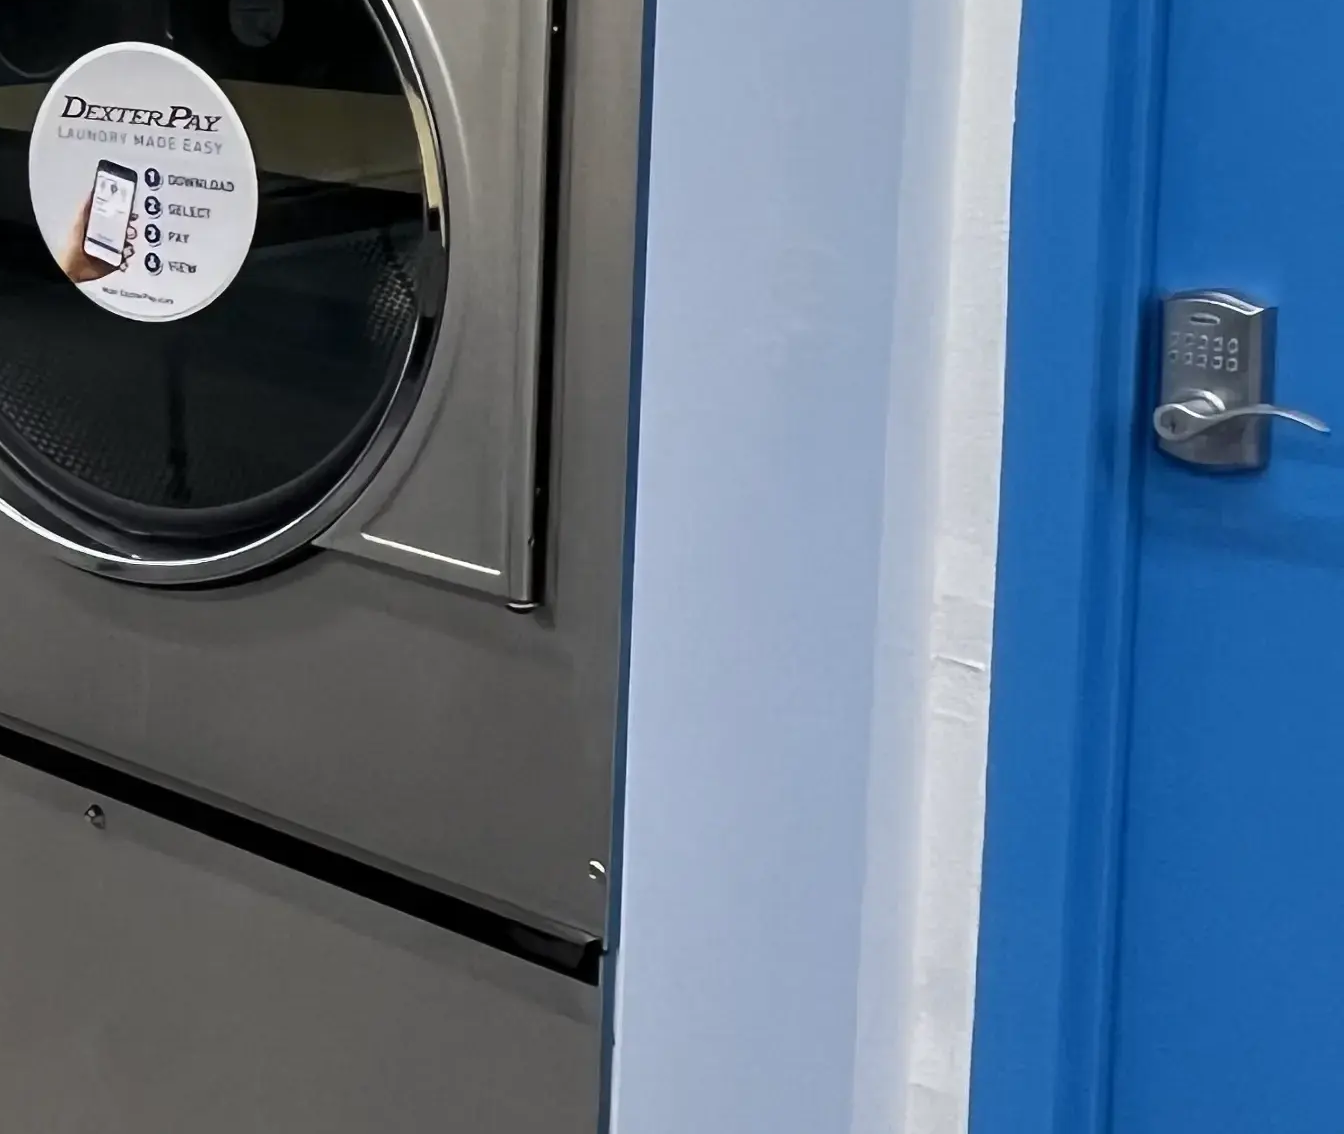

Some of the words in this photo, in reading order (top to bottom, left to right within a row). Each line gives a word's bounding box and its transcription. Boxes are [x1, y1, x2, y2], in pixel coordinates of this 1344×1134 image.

[58, 124, 127, 146] LAUNDRY
[133, 134, 176, 151] MADE
[182, 137, 224, 156] EASY
[167, 174, 235, 192] DOWNLOAD
[167, 231, 190, 244] PAY
